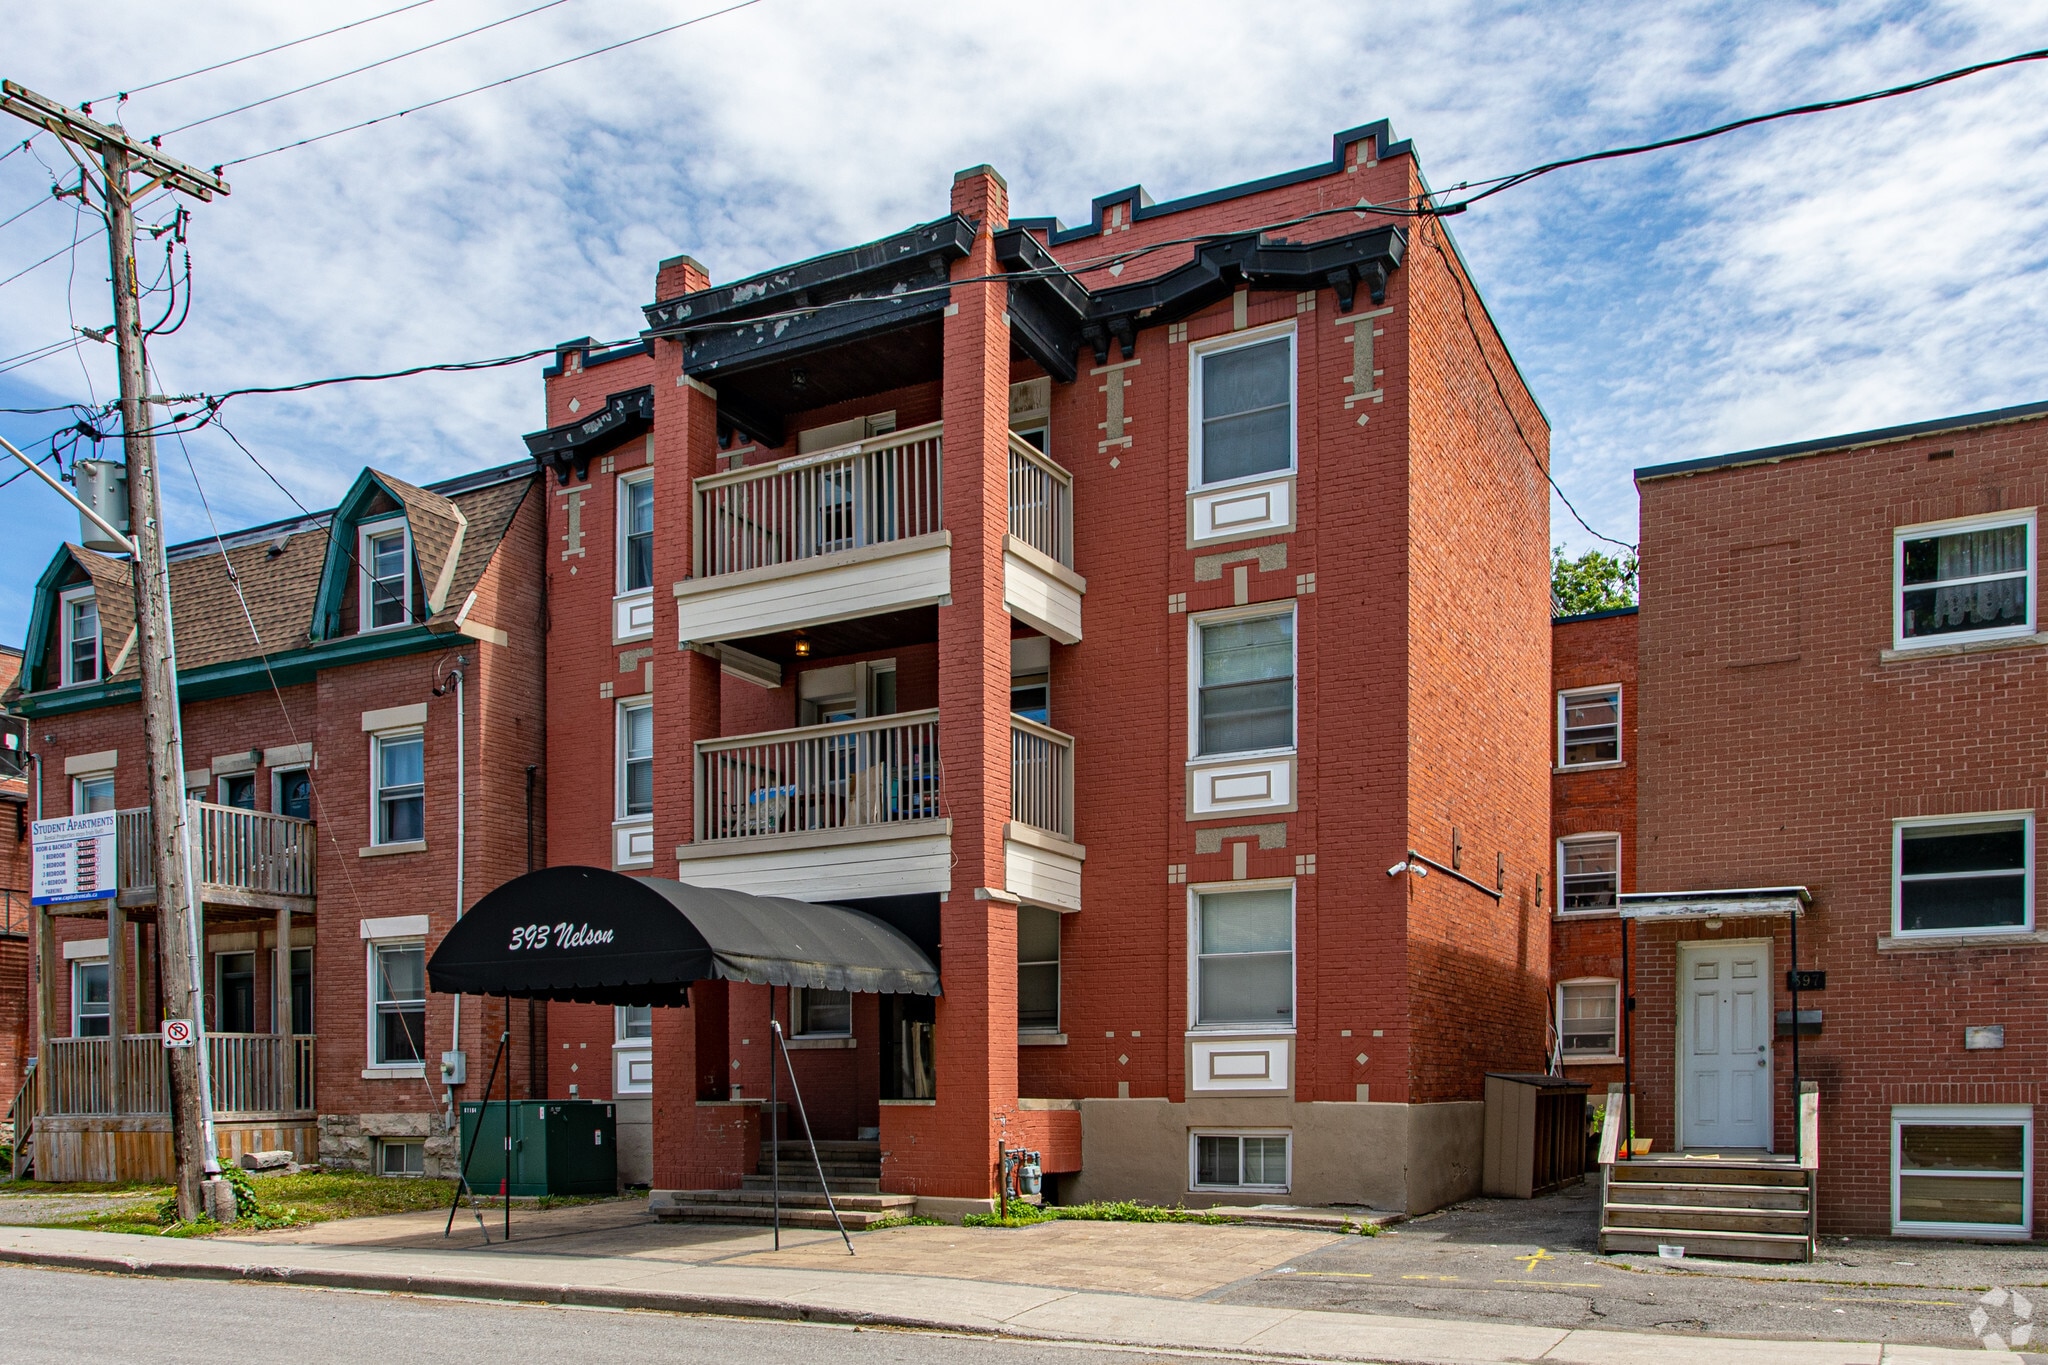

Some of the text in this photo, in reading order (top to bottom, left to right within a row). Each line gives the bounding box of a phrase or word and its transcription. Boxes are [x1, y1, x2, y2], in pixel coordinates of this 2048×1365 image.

[46, 861, 66, 869] BEDROOM
[508, 921, 614, 951] 393 Nelson
